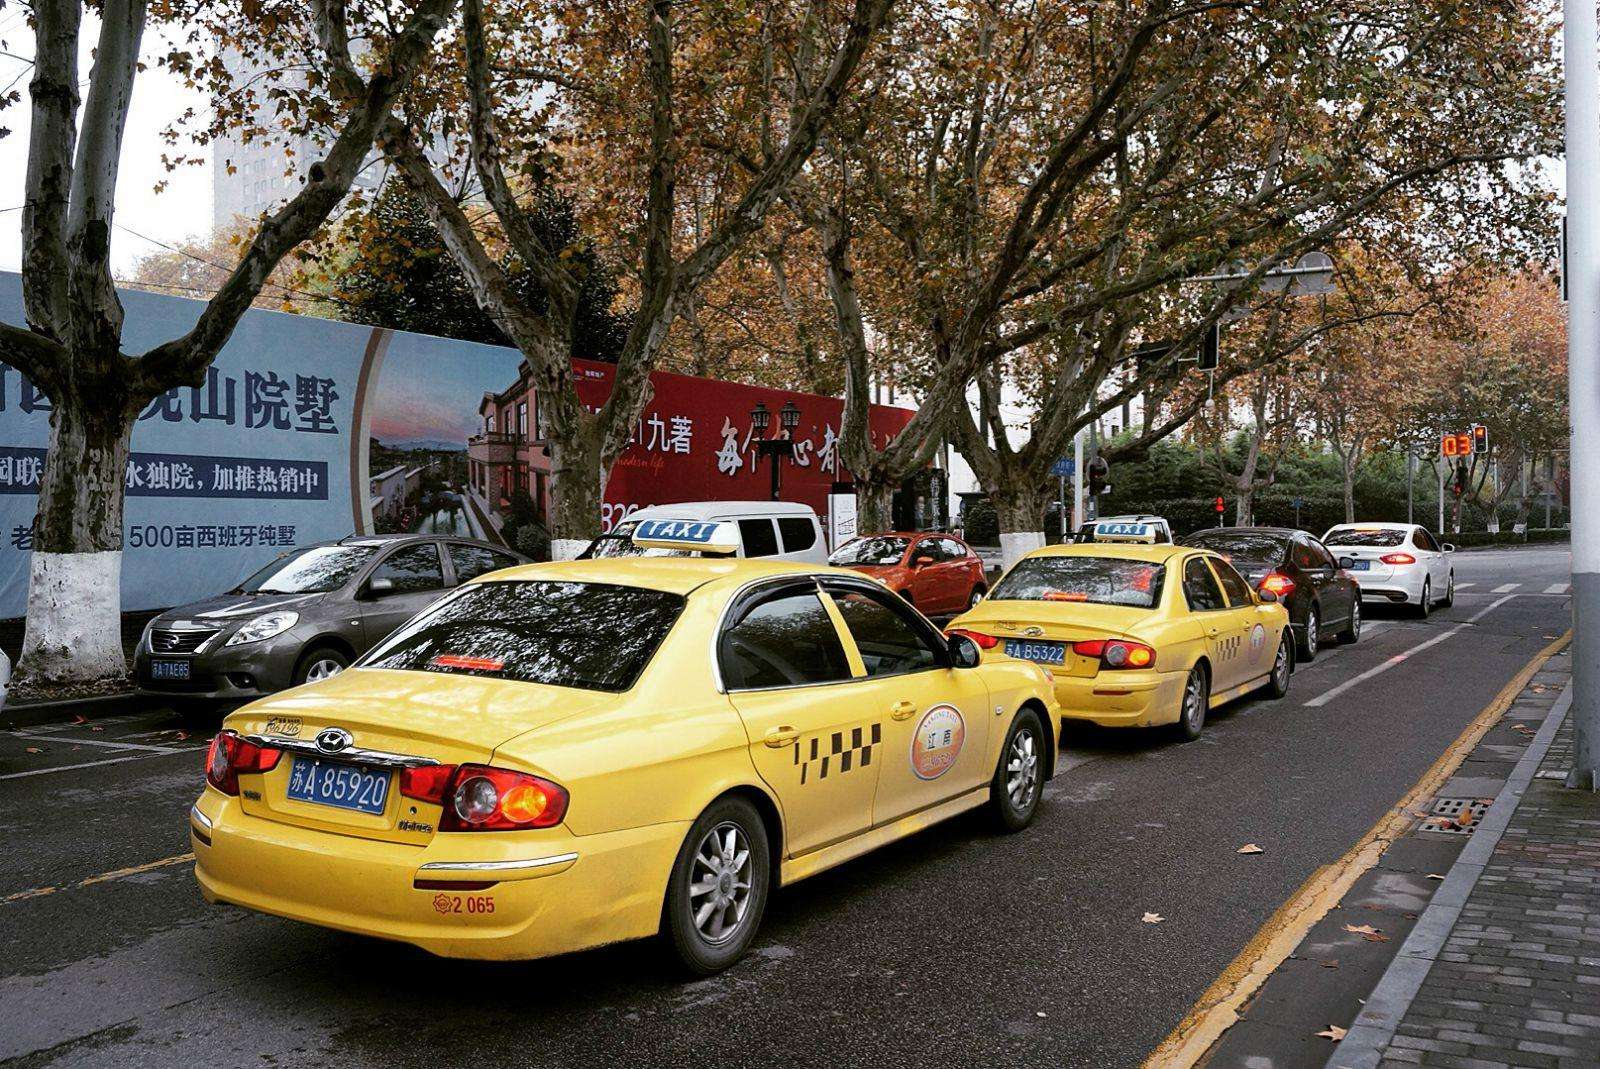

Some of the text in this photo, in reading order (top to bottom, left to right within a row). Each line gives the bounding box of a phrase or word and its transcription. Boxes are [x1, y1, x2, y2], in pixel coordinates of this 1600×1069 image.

[1445, 435, 1470, 456] 03
[129, 525, 296, 549] 500亩西班牙纯墅
[648, 521, 712, 539] TAXI
[1101, 524, 1142, 535] TAXI
